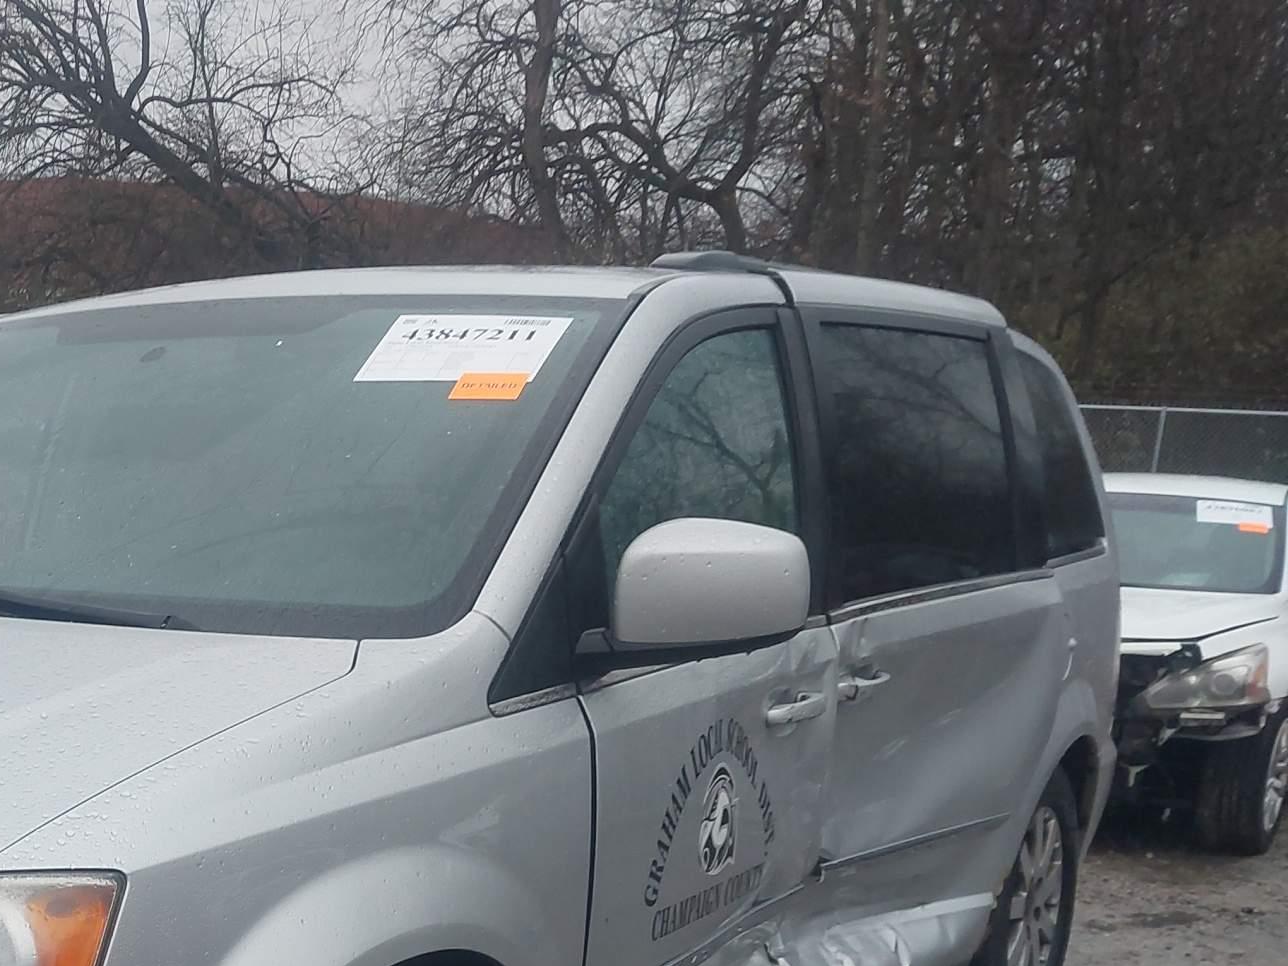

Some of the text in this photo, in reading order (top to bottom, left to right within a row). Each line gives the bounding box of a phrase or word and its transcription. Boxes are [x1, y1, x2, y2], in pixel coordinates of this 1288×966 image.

[402, 328, 538, 342] 43847211
[643, 764, 693, 908] GRAHAM
[651, 881, 725, 942] CHAMPAIGN
